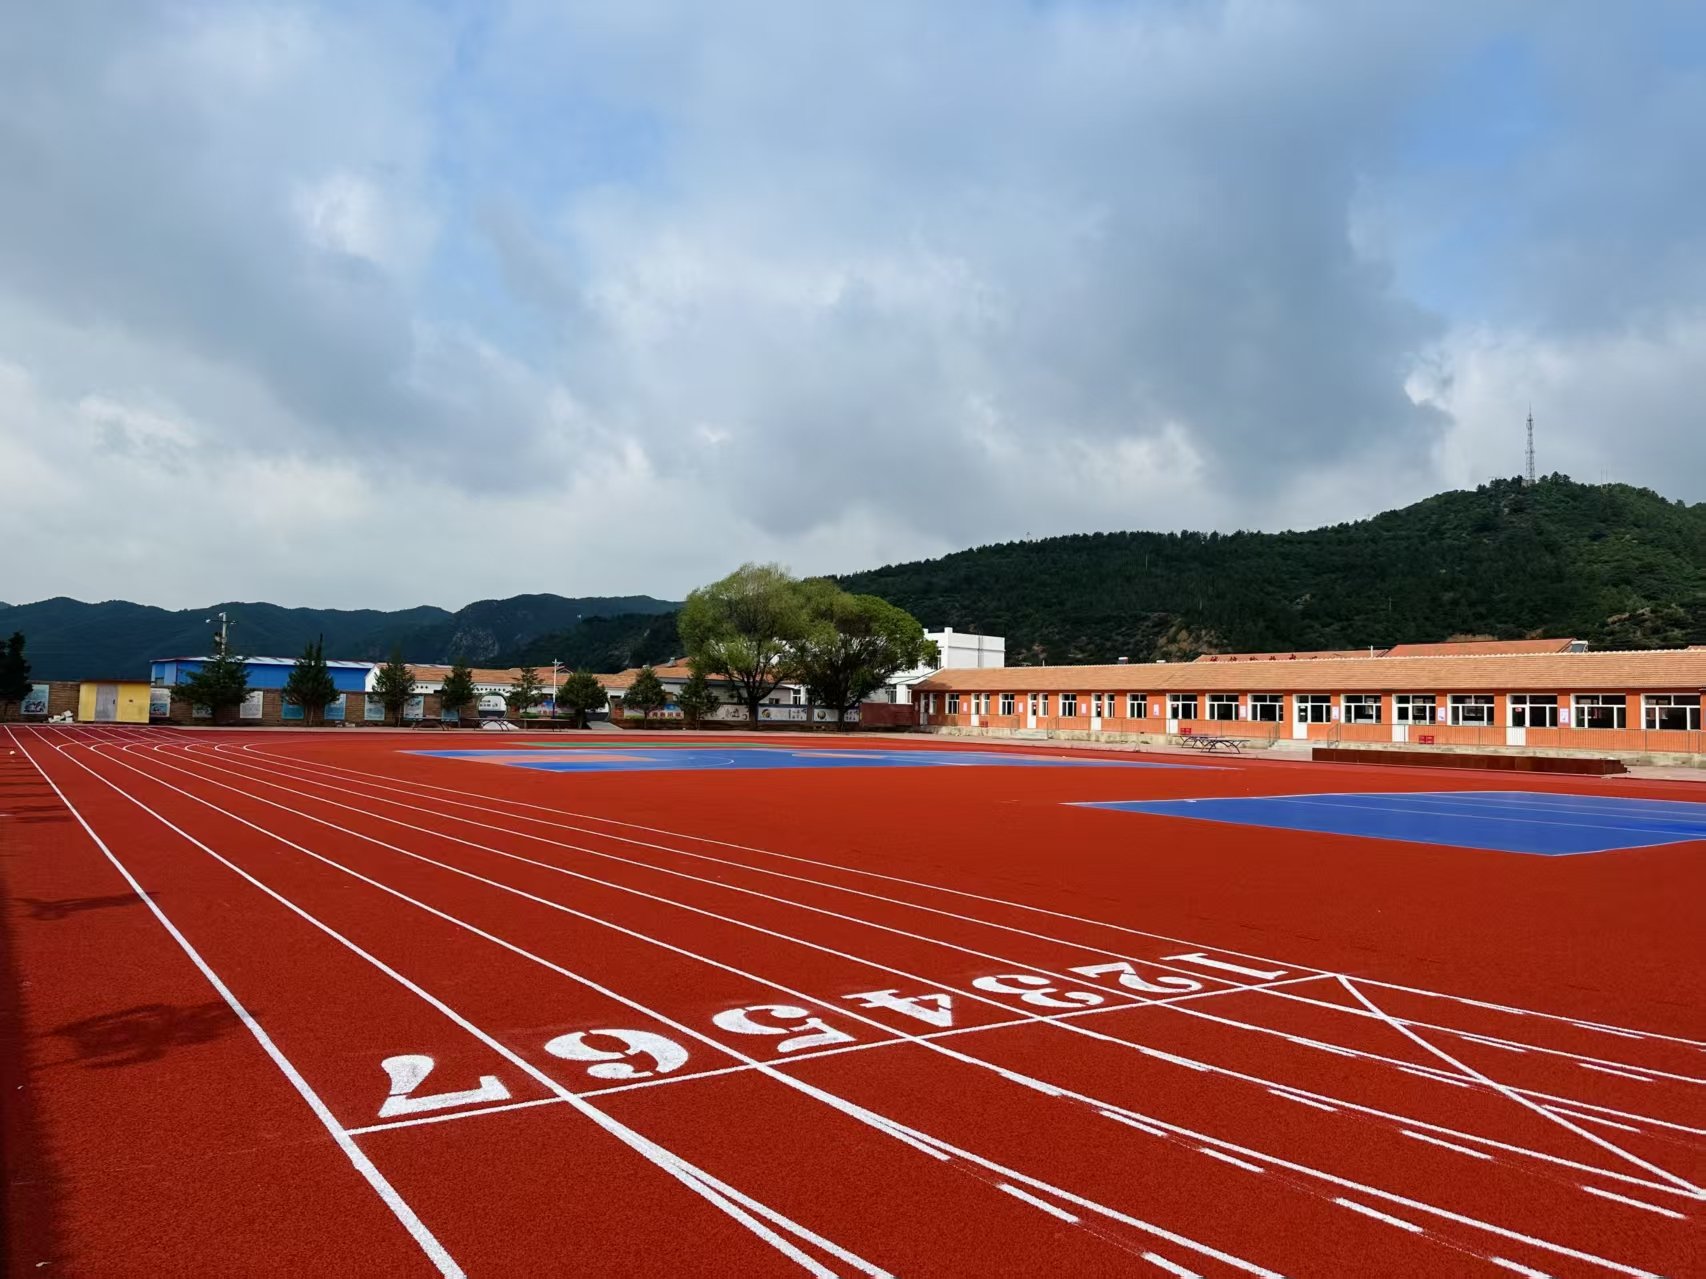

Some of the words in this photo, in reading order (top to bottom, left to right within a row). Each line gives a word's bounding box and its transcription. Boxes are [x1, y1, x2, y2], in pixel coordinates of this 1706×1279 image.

[1068, 962, 1204, 993] 2
[1160, 953, 1288, 980] 1
[842, 989, 954, 1028] 4
[972, 975, 1104, 1008] 3
[712, 1005, 857, 1054] 5
[544, 1030, 689, 1080] 6
[378, 1054, 512, 1118] 7
